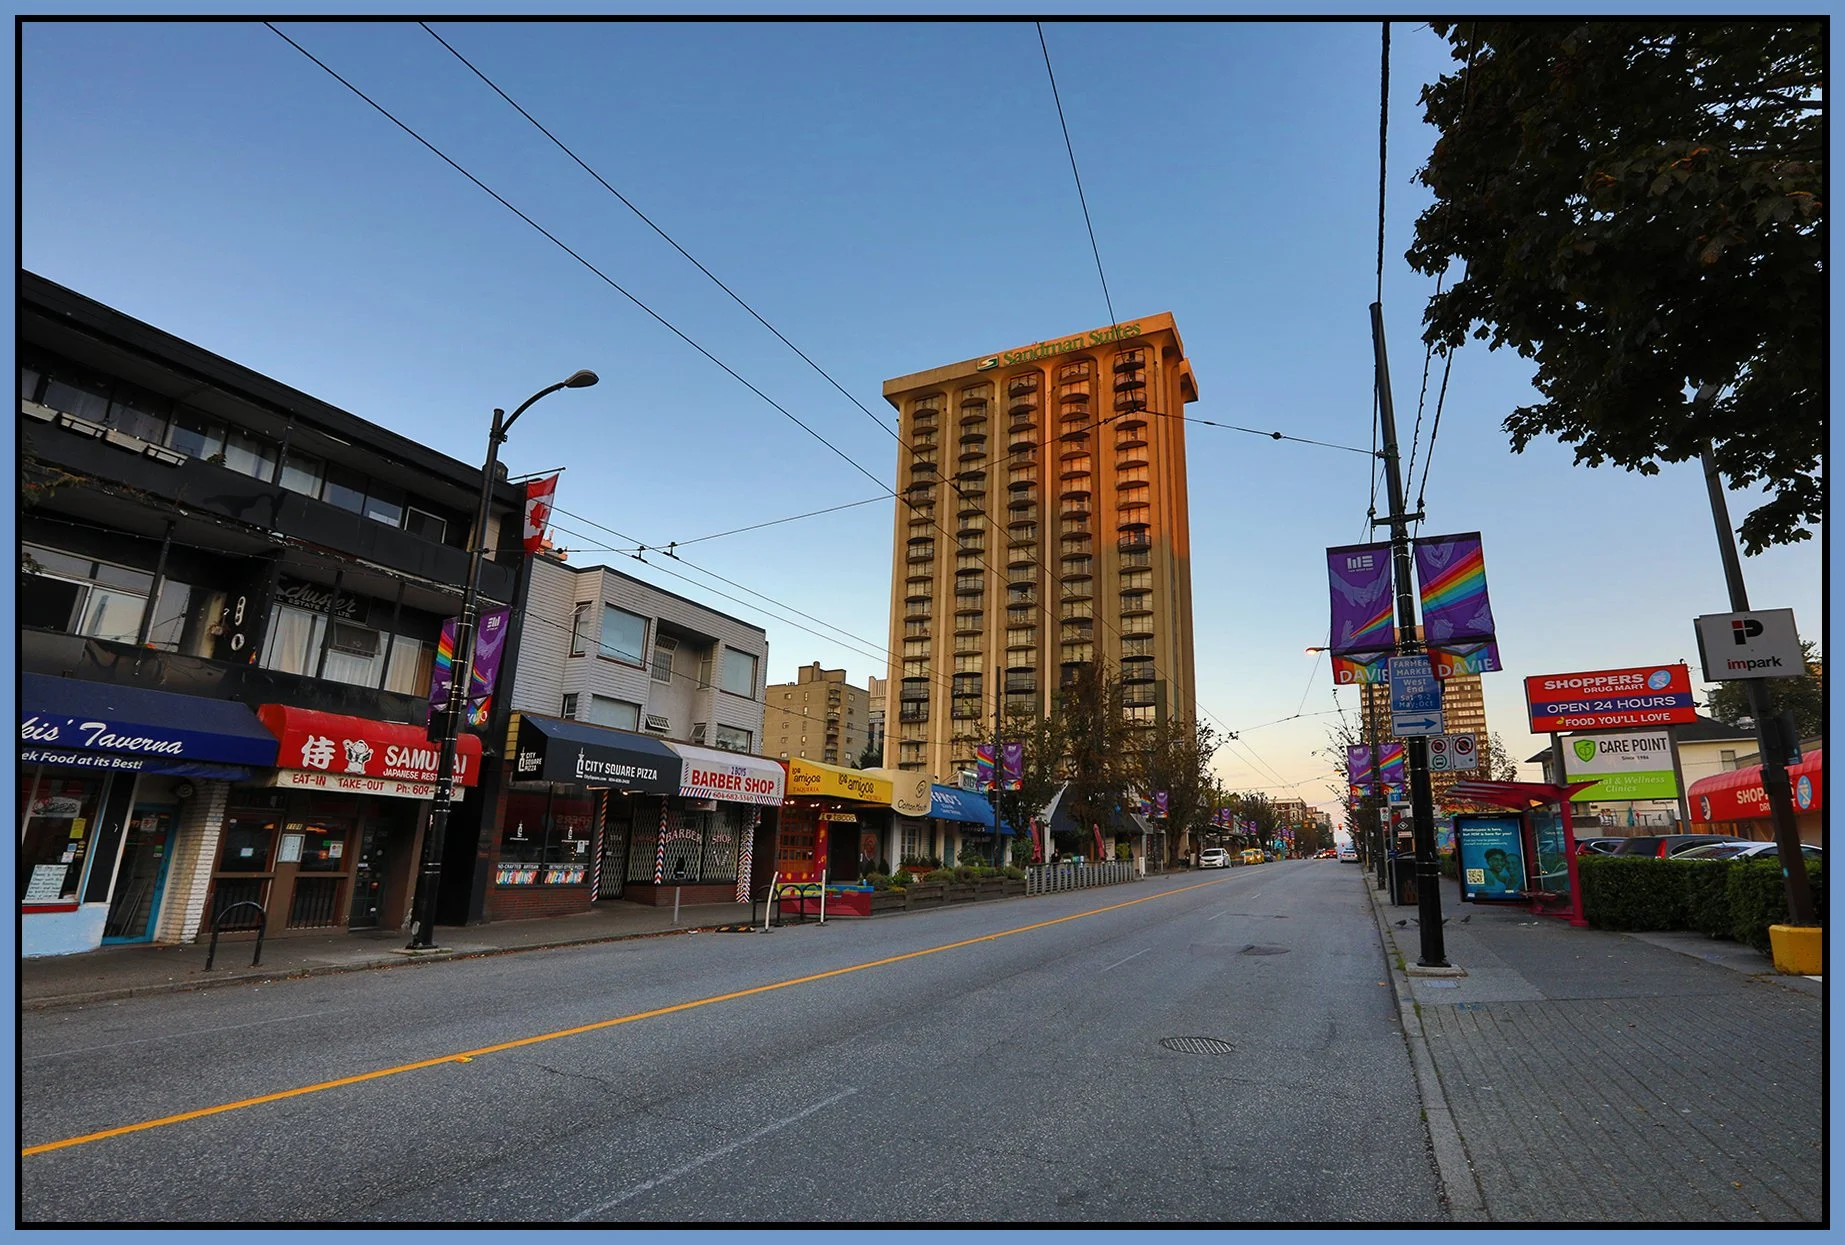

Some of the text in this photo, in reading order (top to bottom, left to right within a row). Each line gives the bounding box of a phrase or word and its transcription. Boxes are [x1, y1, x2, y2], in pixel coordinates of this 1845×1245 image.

[1003, 323, 1142, 366] Sandman Suites
[1438, 658, 1495, 677] DAVIE
[1727, 655, 1783, 671] impark
[1339, 669, 1389, 684] DAVIE
[1403, 678, 1427, 687] West
[1544, 673, 1645, 690] SHOPPERS
[1406, 685, 1424, 693] End
[1583, 683, 1645, 694] DRUG MART
[1546, 696, 1676, 714] OPEN 24 HOURS
[1565, 713, 1671, 727] FOOD YOU'LL LOVE
[80, 722, 184, 754] Taverna
[1600, 737, 1667, 754] CARE POINT
[40, 752, 77, 764] Food
[78, 756, 93, 766] at
[94, 756, 110, 767] its
[111, 759, 143, 769] Best!
[301, 734, 336, 770] 侍
[384, 745, 467, 774] SAMUAI
[383, 768, 419, 780] JAPANESE
[585, 760, 604, 773] CITY
[605, 762, 635, 778] SQUARE
[636, 768, 658, 781] PIZZA
[292, 773, 326, 786] EAT-IN
[338, 777, 385, 791] TAKE-OUT
[396, 783, 411, 793] Ph:
[692, 769, 775, 794] BARBER SHOP
[794, 773, 821, 786] amigos
[848, 777, 875, 797] amigos
[1624, 775, 1665, 784] Wellness
[1605, 785, 1637, 793] Clinics
[666, 828, 702, 845] BARBER
[712, 832, 732, 844] SHOP
